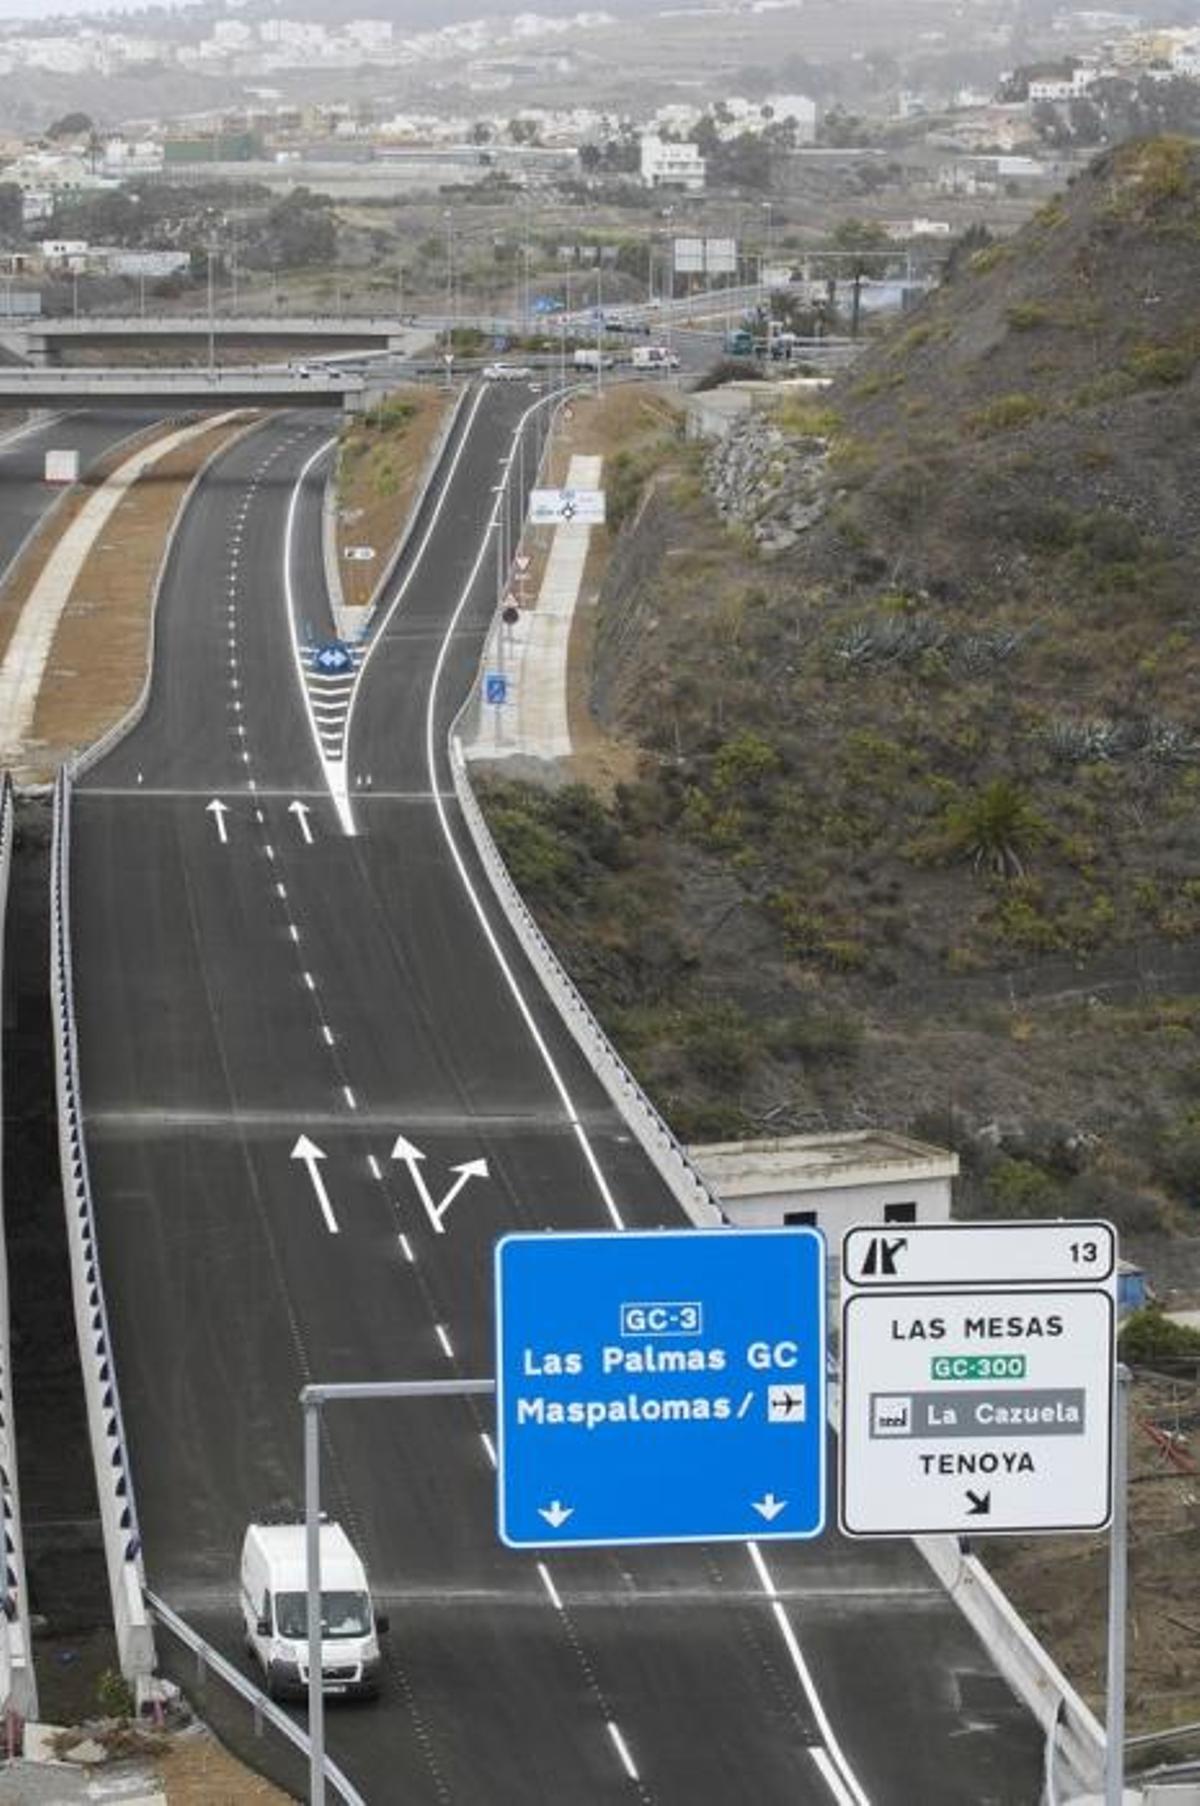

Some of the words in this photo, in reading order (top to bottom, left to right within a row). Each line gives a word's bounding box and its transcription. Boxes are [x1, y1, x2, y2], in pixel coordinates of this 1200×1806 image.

[1069, 1243, 1097, 1263] 13
[626, 1308, 698, 1331] GC-3
[891, 1319, 947, 1340] LAS
[964, 1316, 1064, 1338] MESAS
[523, 1348, 582, 1375] Las
[603, 1344, 726, 1373] Palmas
[747, 1341, 798, 1368] GC
[934, 1357, 1024, 1377] GC-300
[927, 1404, 957, 1425] La
[975, 1403, 1080, 1424] Cazuela
[920, 1452, 1035, 1475] TENOYA
